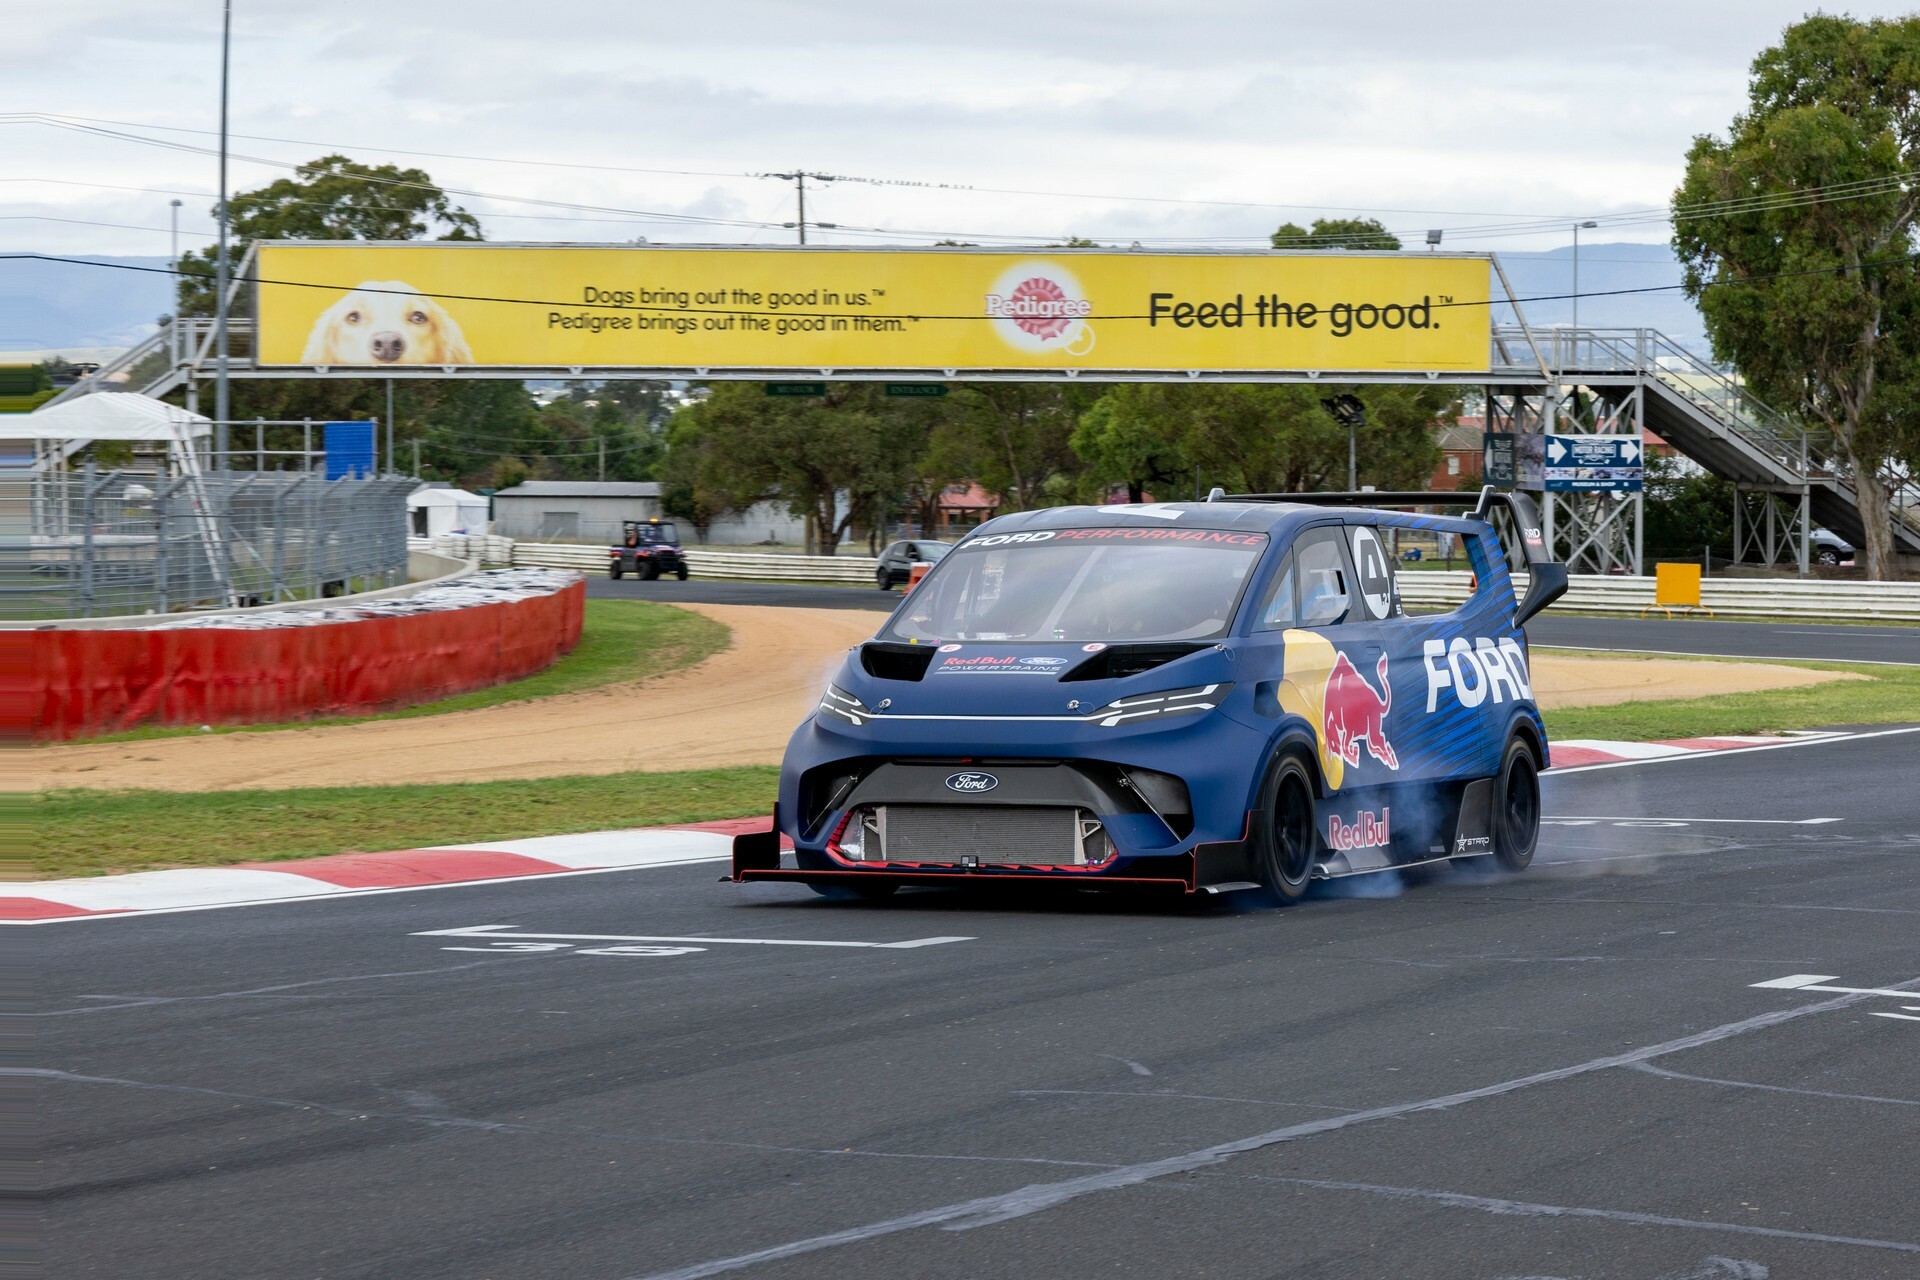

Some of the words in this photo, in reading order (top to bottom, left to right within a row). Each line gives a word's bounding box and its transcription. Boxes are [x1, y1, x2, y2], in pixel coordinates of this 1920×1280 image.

[584, 286, 635, 308] Dogs
[640, 287, 689, 308] bring
[695, 289, 727, 305] out
[731, 289, 762, 305] the
[768, 289, 817, 309] good
[823, 289, 839, 305] in
[984, 293, 1092, 318] Pedigree
[1150, 292, 1243, 328] Feed
[1255, 294, 1317, 328] the
[548, 312, 632, 333] Pedigree
[638, 313, 698, 334] brings
[703, 315, 736, 331] out
[739, 315, 771, 331] the
[776, 315, 826, 335] good
[831, 315, 847, 332] in
[890, 384, 938, 395] ENTRANCE
[960, 531, 1056, 549] FORD
[1055, 529, 1266, 546] PERFORMANCE
[1423, 637, 1535, 713] FORD
[955, 774, 988, 789] Ford
[1467, 837, 1490, 846] STARD
